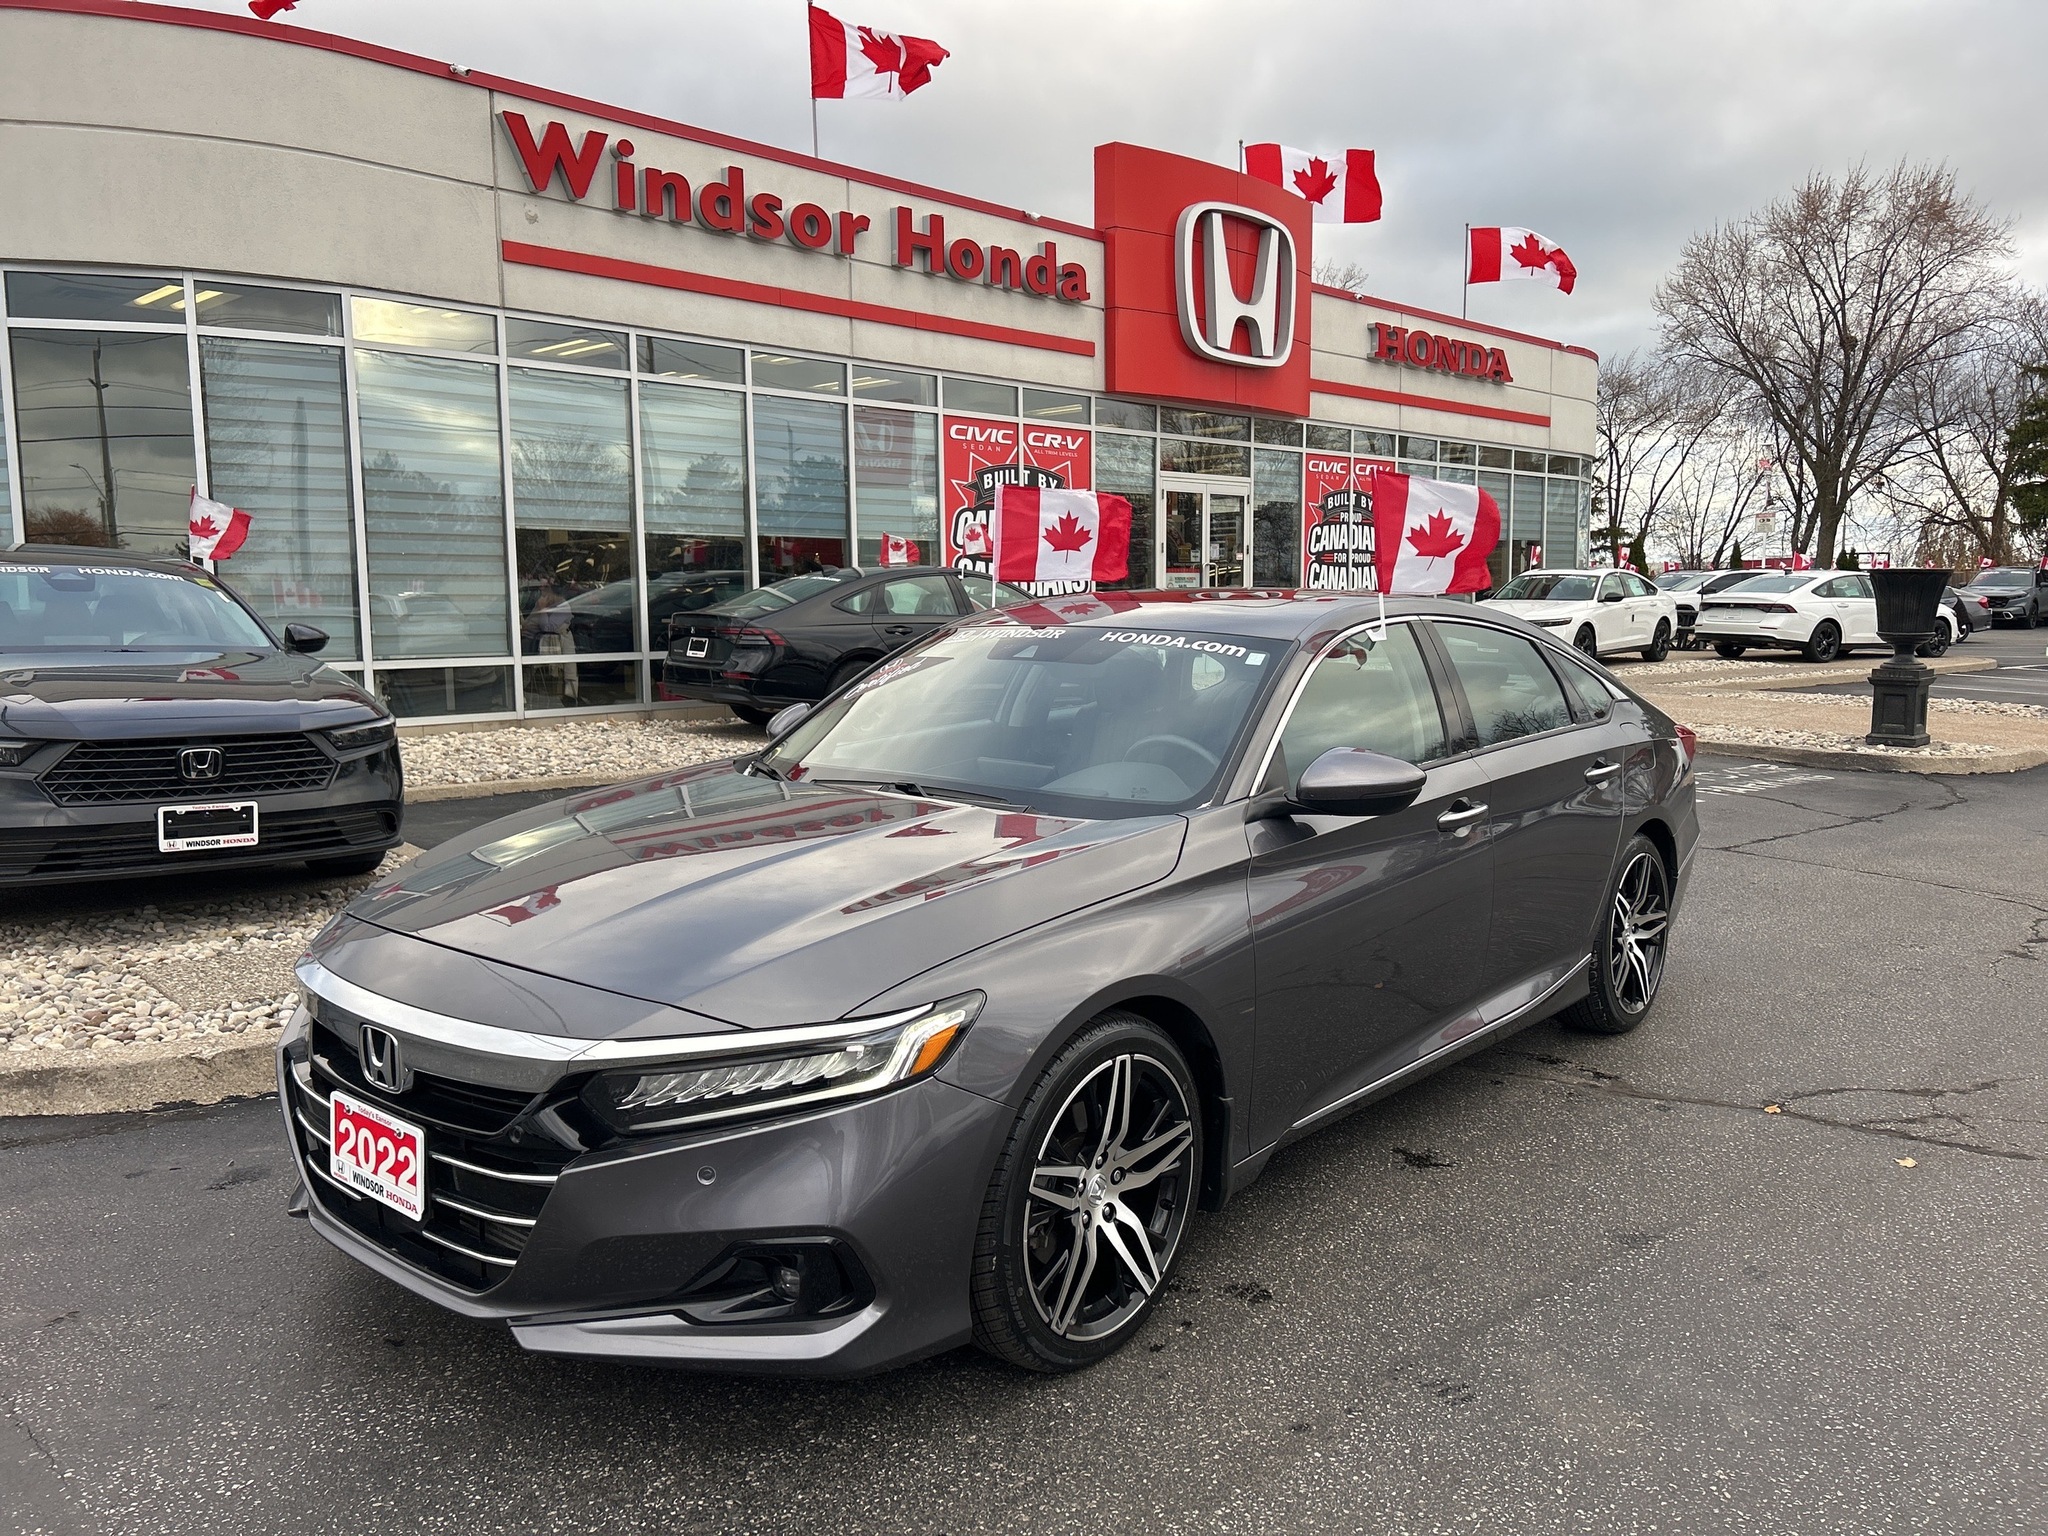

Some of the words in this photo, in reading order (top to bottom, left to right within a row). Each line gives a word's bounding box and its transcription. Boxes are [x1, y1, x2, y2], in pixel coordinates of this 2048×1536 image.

[498, 110, 870, 256] Windsor
[891, 205, 1090, 301] Honda
[1368, 322, 1514, 383] HONDA
[949, 424, 1014, 445] CIVIC
[1027, 432, 1084, 450] CR-V
[962, 442, 1001, 452] SEDAN
[1308, 460, 1348, 474] CIVIC
[983, 469, 1031, 490] BUILT
[1327, 492, 1357, 510] BUILT
[1360, 495, 1374, 511] BY
[1333, 552, 1347, 563] FOR
[1351, 553, 1372, 563] PROUD
[77, 567, 185, 581] HONDA.com
[981, 628, 1067, 640] WINDSOR
[1099, 631, 1247, 658] HONDA.com
[186, 839, 221, 848] WINDSOR
[222, 837, 256, 845] HONDA
[338, 1118, 417, 1196] 2022
[352, 1170, 384, 1198] WINDSOR
[385, 1190, 419, 1214] HONDA
